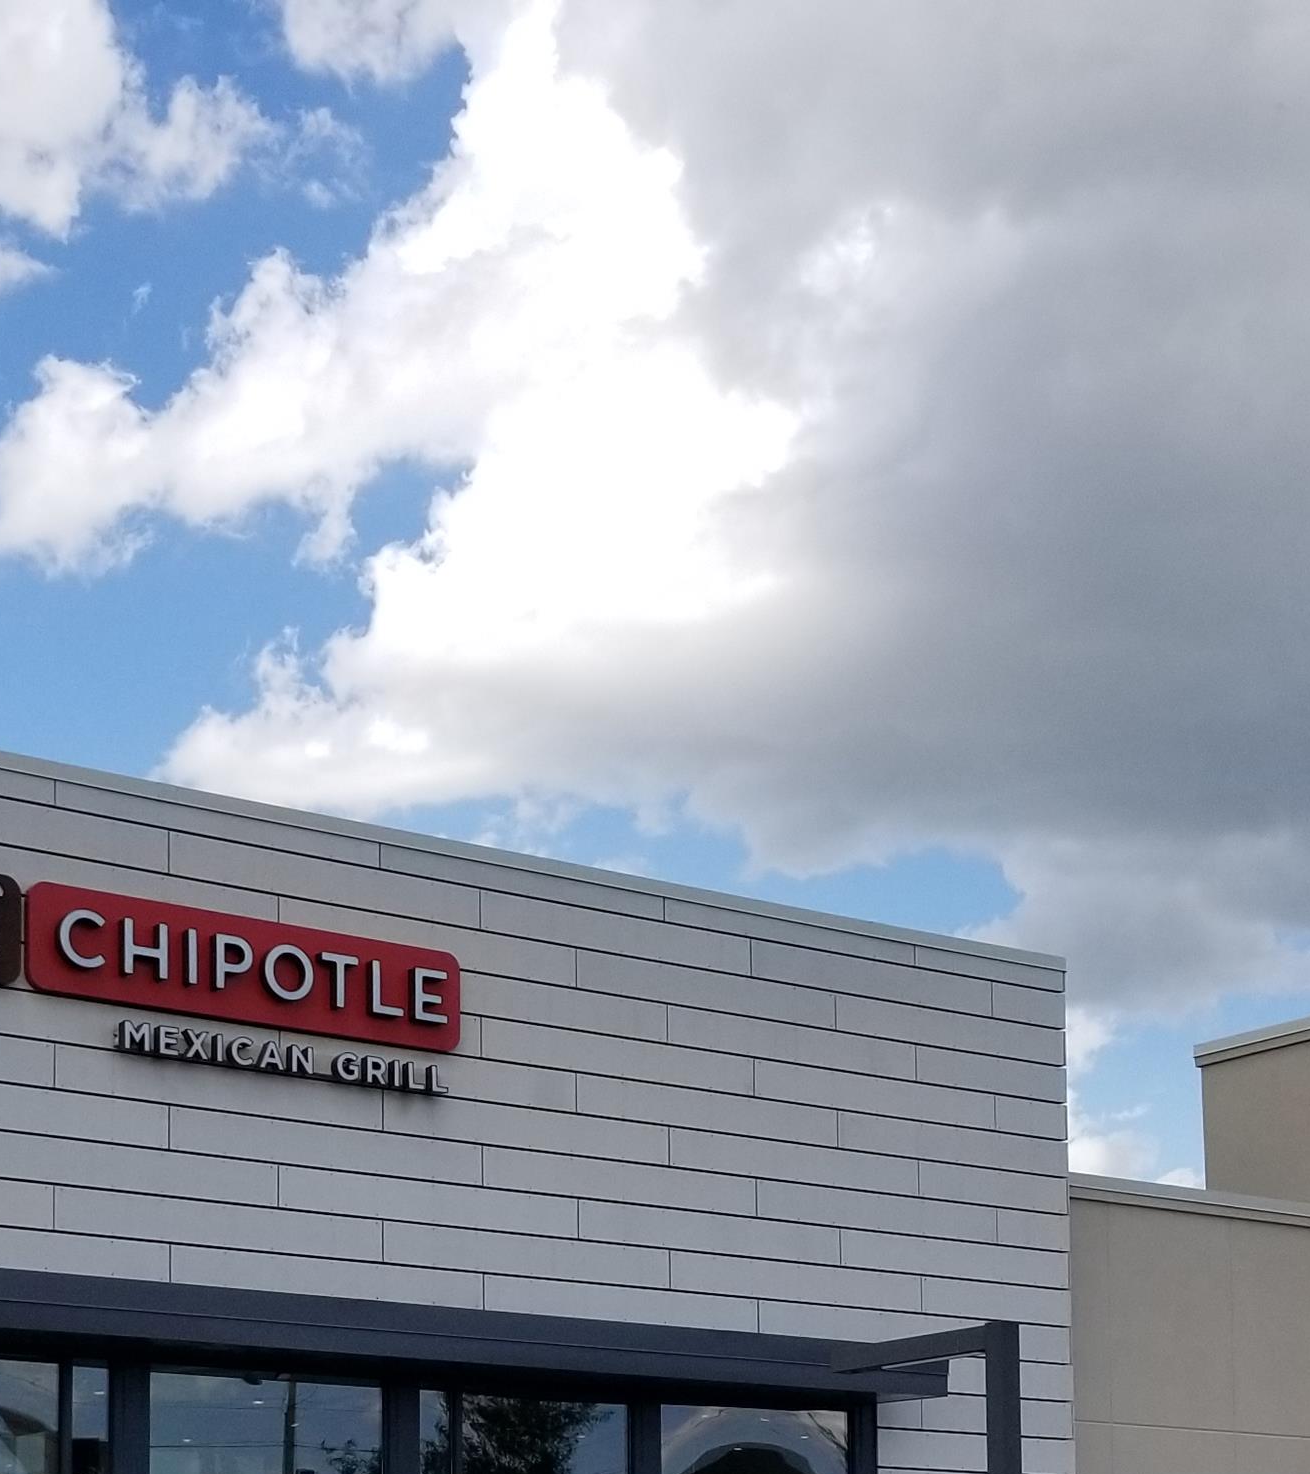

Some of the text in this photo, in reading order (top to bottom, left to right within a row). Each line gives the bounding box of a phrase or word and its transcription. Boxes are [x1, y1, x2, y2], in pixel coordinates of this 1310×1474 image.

[57, 908, 449, 1025] CHIPOTLE
[120, 1019, 449, 1094] MEXICAN GRILL
